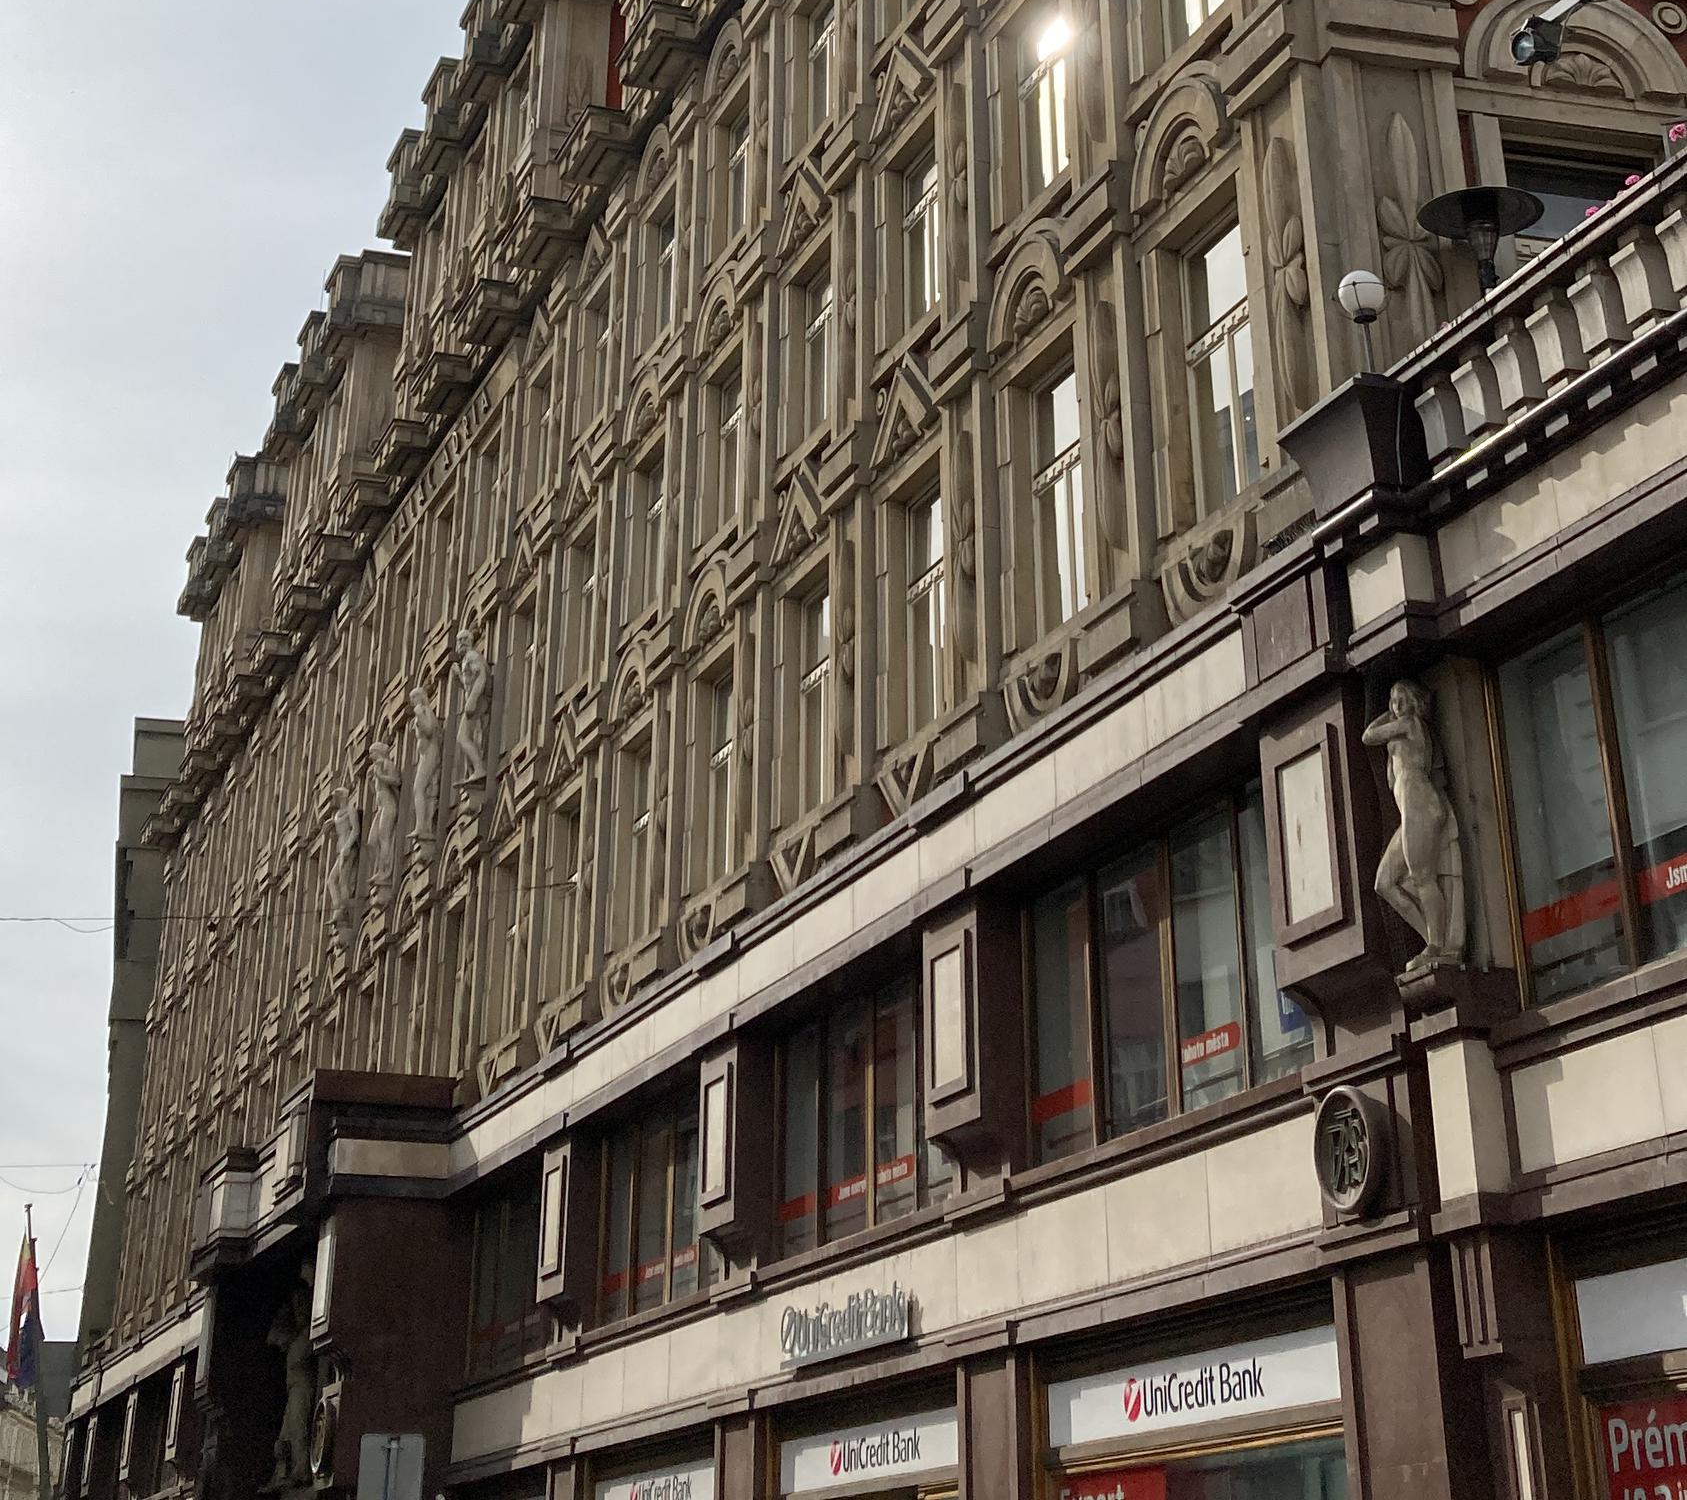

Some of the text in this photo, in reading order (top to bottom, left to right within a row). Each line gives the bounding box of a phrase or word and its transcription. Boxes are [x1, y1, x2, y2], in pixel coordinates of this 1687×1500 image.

[1142, 1357, 1265, 1418] UniCredit Bank
[842, 1427, 921, 1473] UniCredit Bank
